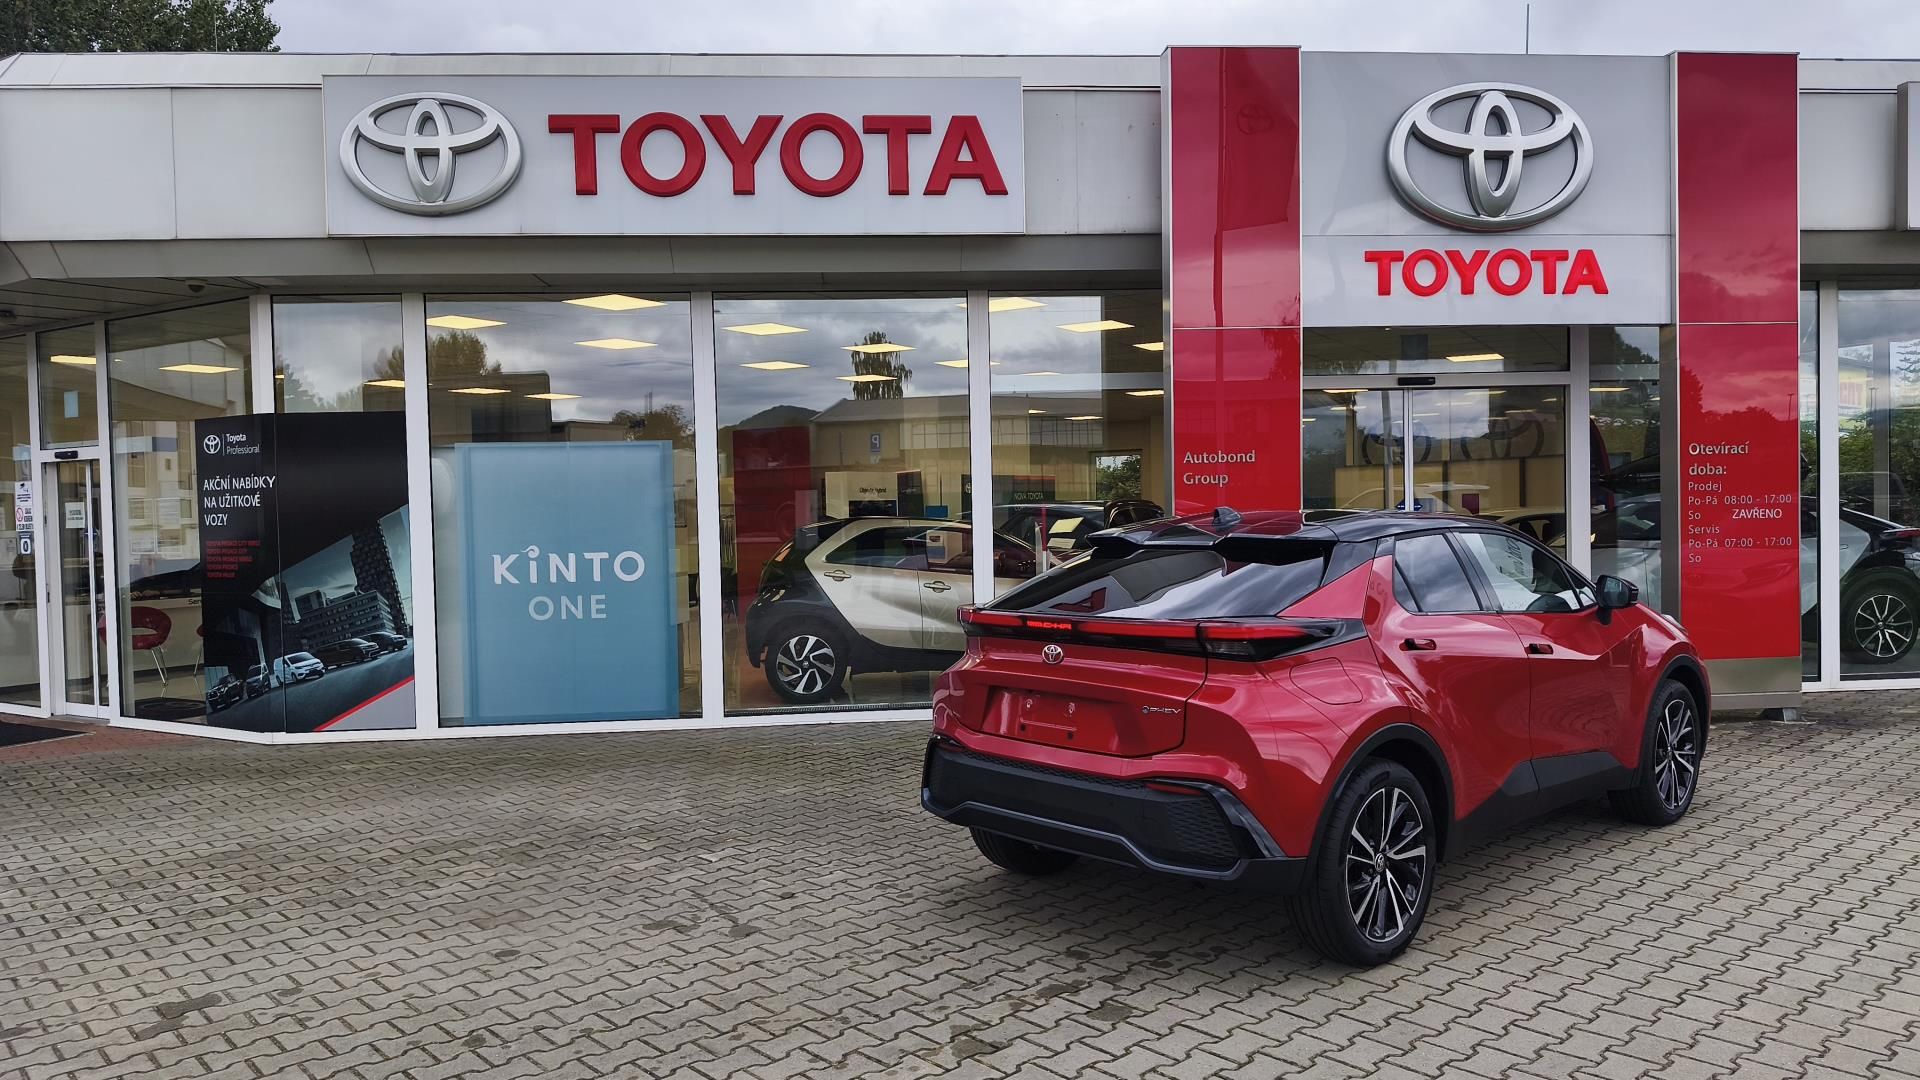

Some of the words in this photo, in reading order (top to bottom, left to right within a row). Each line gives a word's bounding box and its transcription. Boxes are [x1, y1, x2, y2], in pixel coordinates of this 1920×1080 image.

[548, 111, 1009, 198] TOYOTA
[1364, 248, 1609, 297] TOYOTA
[225, 433, 247, 444] Toyota
[226, 443, 260, 455] Professional
[1688, 441, 1750, 455] Otevírací
[1183, 450, 1256, 464] Autobond
[1688, 463, 1727, 476] doba:
[203, 475, 231, 491] AKČNÍ
[232, 473, 276, 490] NABÍDKY
[1183, 472, 1229, 488] Group
[1688, 481, 1722, 493] Prodej
[204, 496, 217, 509] NA
[218, 491, 261, 508] UŽITKOVÉ
[1688, 495, 1718, 506] Po-Pá
[1724, 495, 1753, 505] 08:00
[1764, 494, 1792, 504] 17:00
[204, 513, 228, 526] VOZY
[1688, 511, 1701, 520] So
[1732, 507, 1783, 519] ZAVŘENO
[1688, 524, 1720, 535] Servis
[1688, 538, 1719, 549] Po-Pá
[1724, 538, 1753, 548] 07:00
[1765, 537, 1792, 546] 17:00
[1688, 553, 1702, 563] So
[528, 594, 607, 621] ONE
